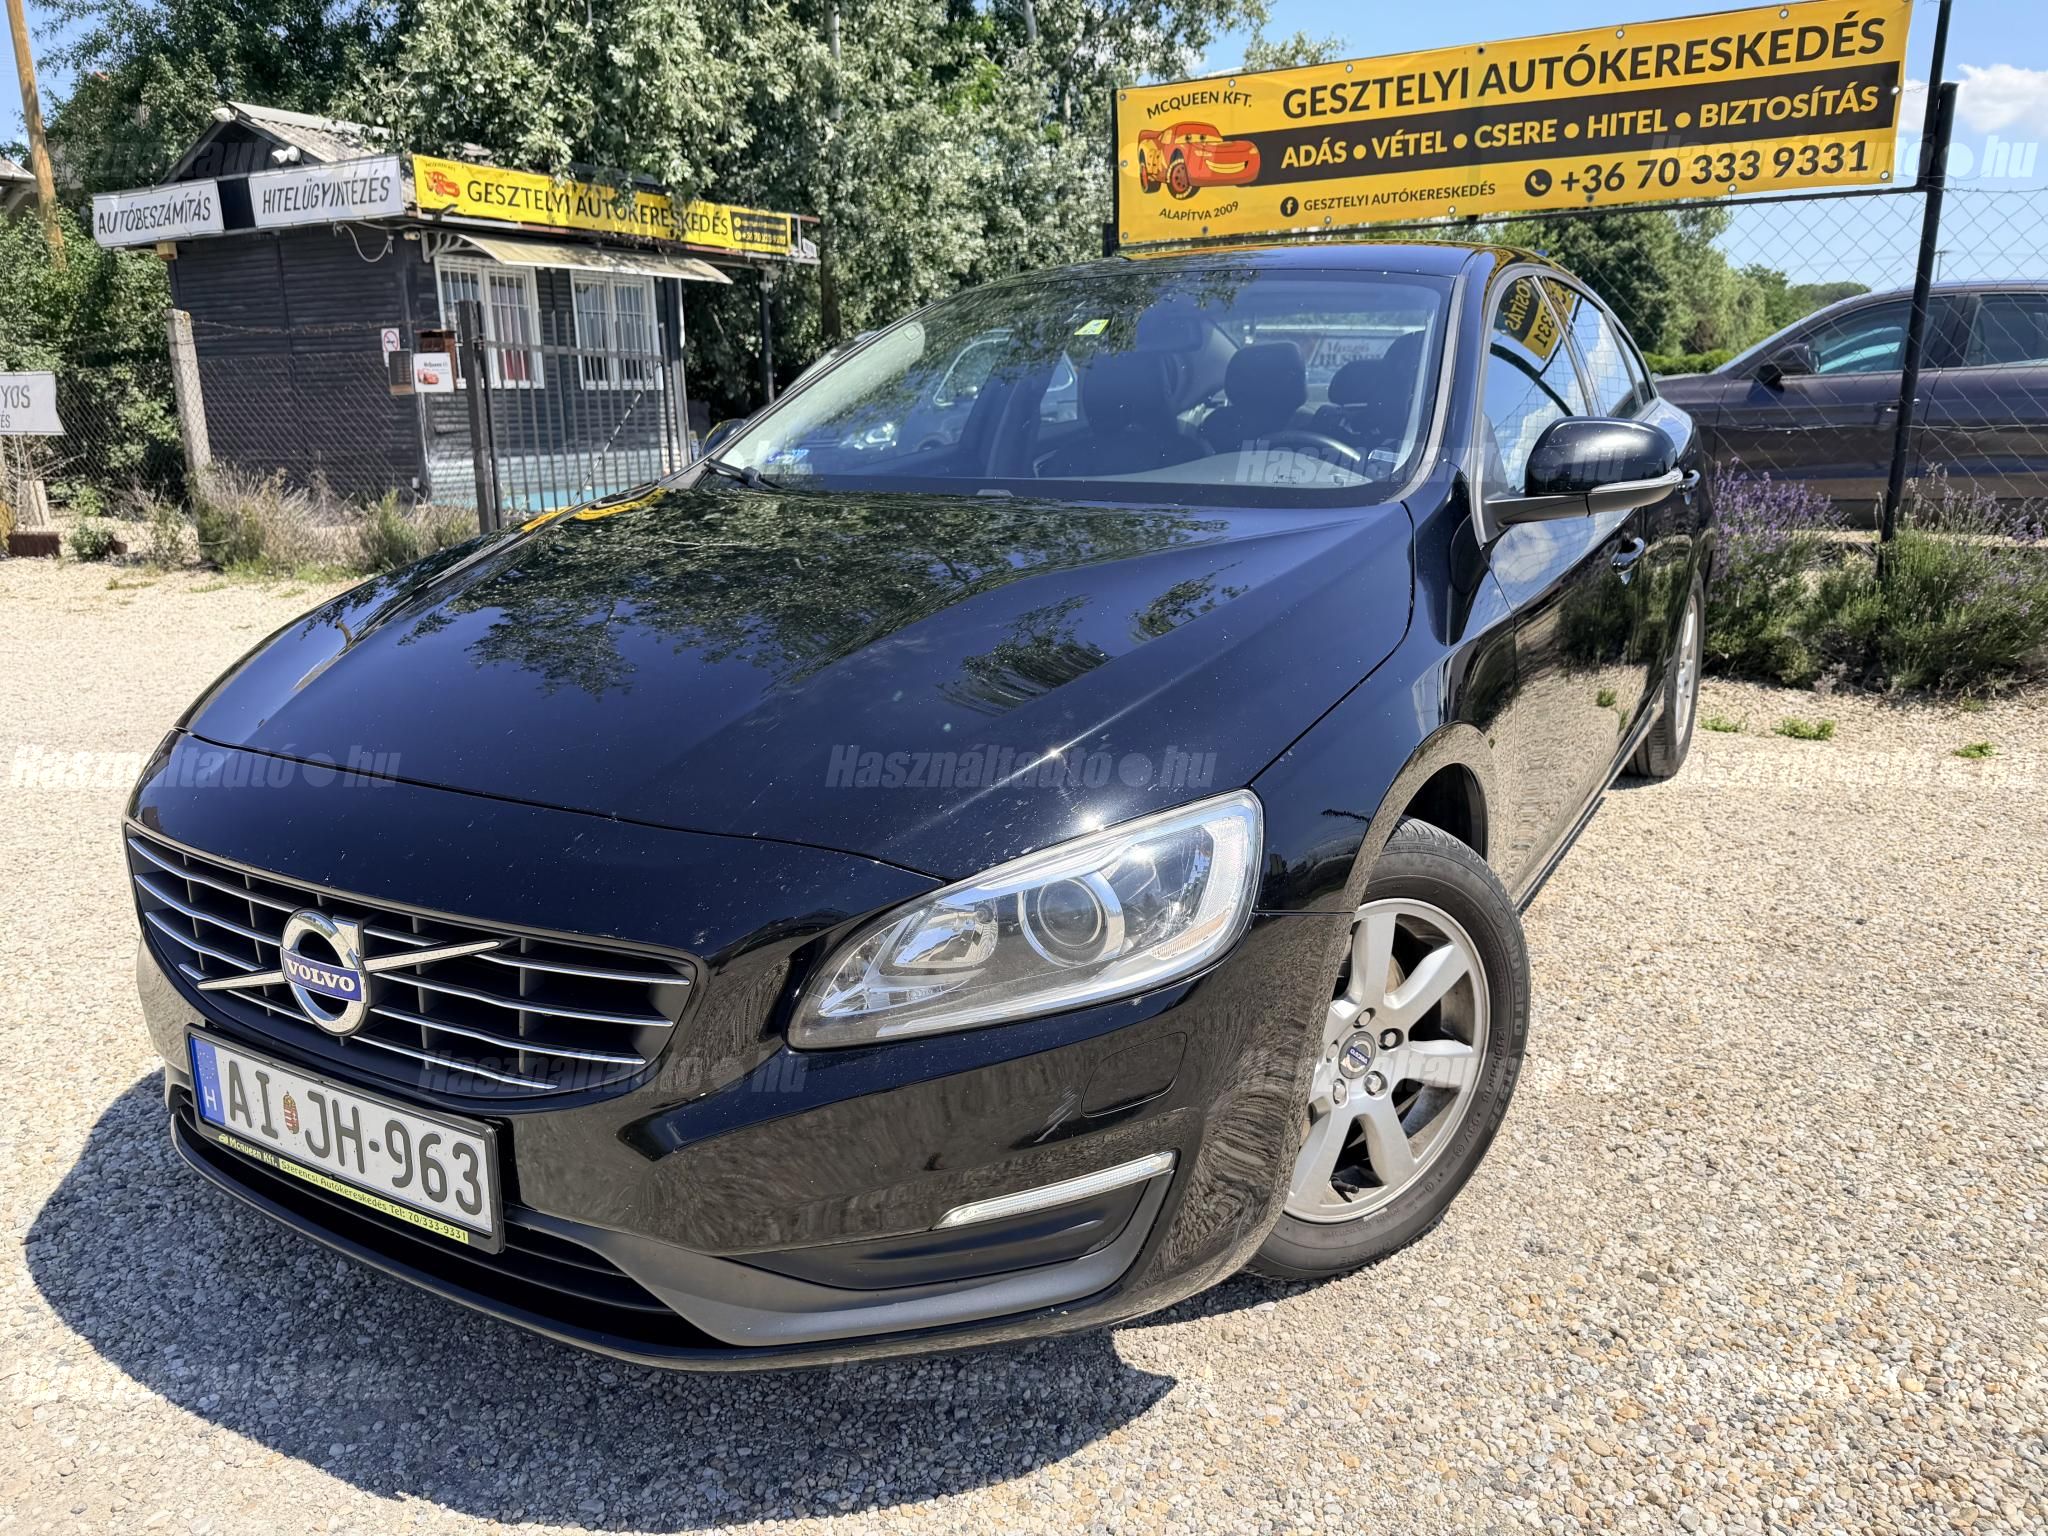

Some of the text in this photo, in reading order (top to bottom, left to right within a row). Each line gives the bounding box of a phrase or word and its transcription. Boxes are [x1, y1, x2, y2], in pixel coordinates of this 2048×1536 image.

[1283, 10, 1886, 119] GESZTELYI AUTÓKERESKEDÉS
[1146, 91, 1252, 119] MCQUEEN KFT.
[1280, 82, 1879, 169] ADÁS VÉTEL CSERE HITEL BIZTOSÍTÁS
[1560, 141, 1868, 194] +36 70 333 9331
[98, 170, 390, 235] AUTÓBESZÁMÍTÁS HITELÜGYINTÉZÉS
[467, 180, 571, 215] GESZTELYI
[1159, 201, 1239, 221] ALAPÍTVA 2009
[1303, 181, 1496, 212] GESZTELYI AUTÓKERESKEDÉS
[285, 961, 355, 993] VOLVO
[205, 1086, 217, 1111] H
[229, 1061, 482, 1216] AI JH-963
[281, 1161, 318, 1183] Szerencsi
[390, 1205, 405, 1218] Tel:
[408, 1212, 467, 1240] 70/333-9331
